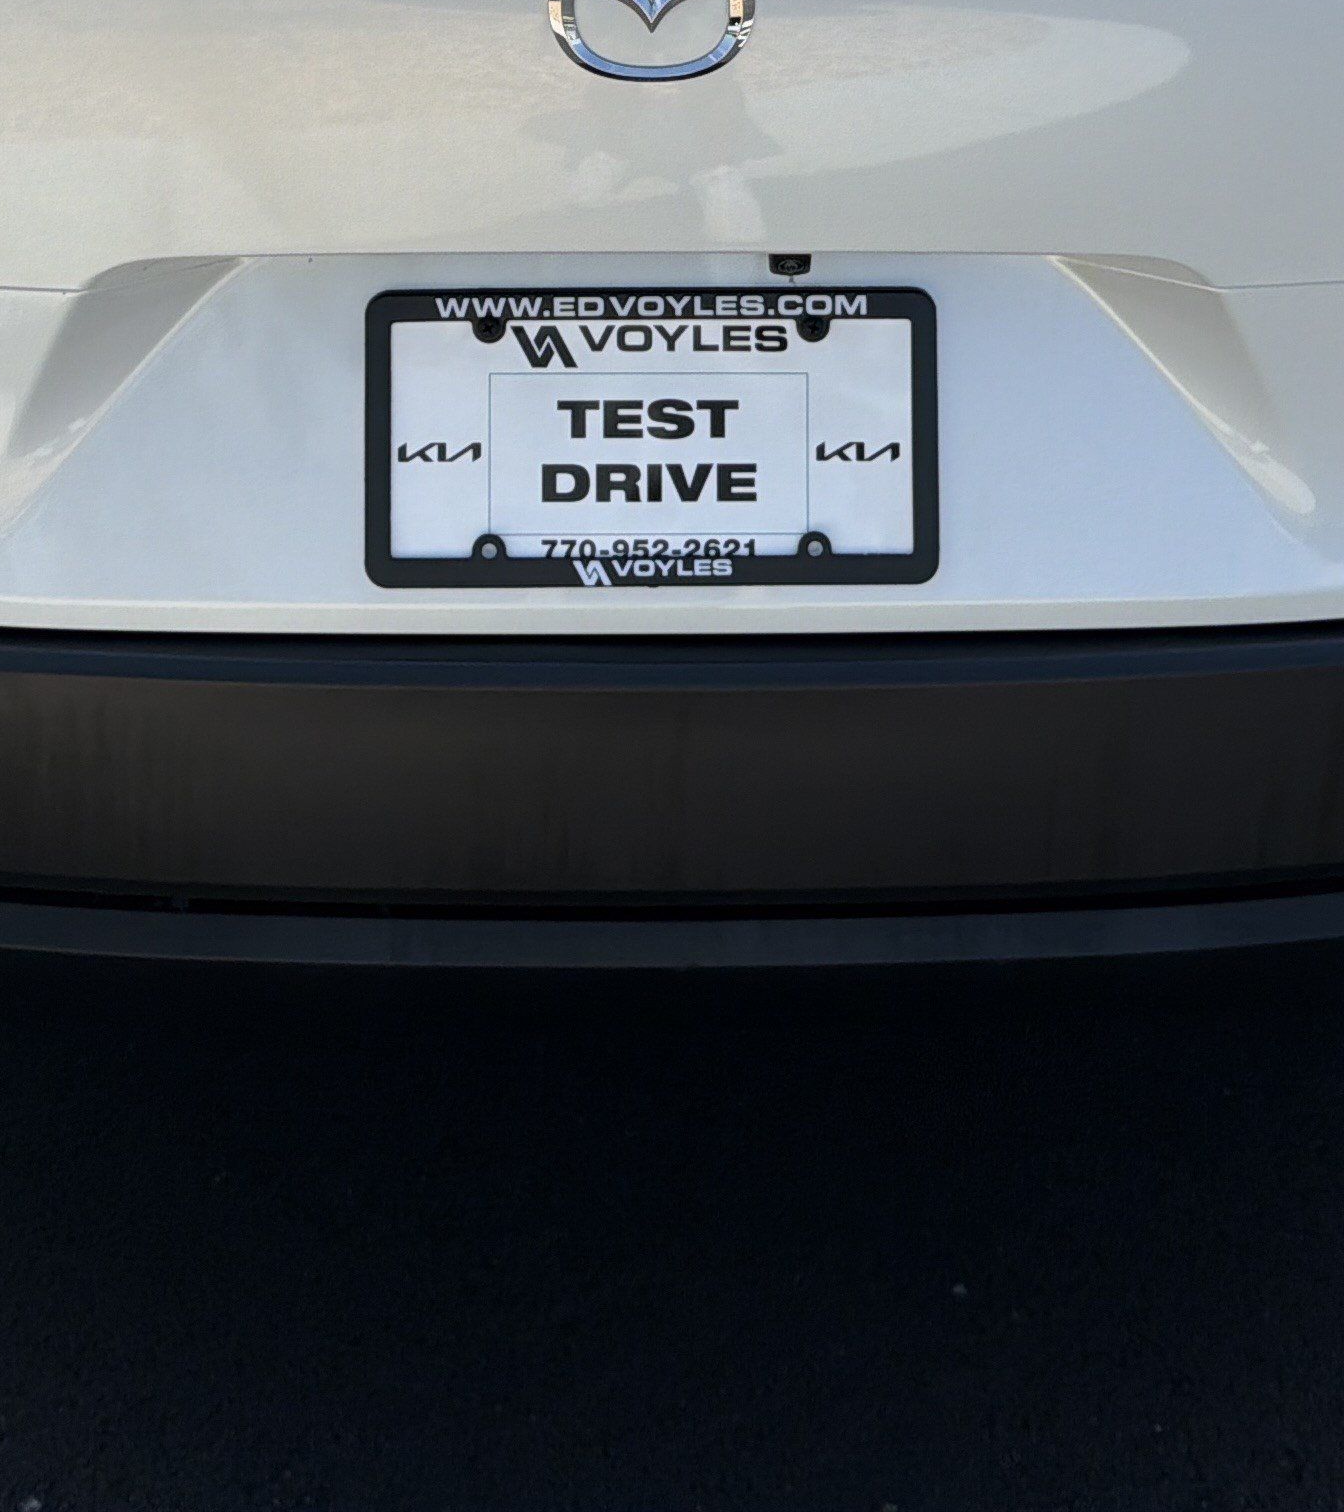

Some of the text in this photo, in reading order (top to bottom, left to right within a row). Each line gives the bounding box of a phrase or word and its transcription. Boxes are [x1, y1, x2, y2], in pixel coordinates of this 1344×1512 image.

[436, 294, 867, 318] WWW.EDVOYLES.COM
[582, 324, 789, 352] VOYLES
[557, 399, 739, 439] TEST
[541, 463, 758, 502] DRIVE
[541, 538, 756, 558] 770-952-2621
[611, 559, 733, 577] VOYLES
